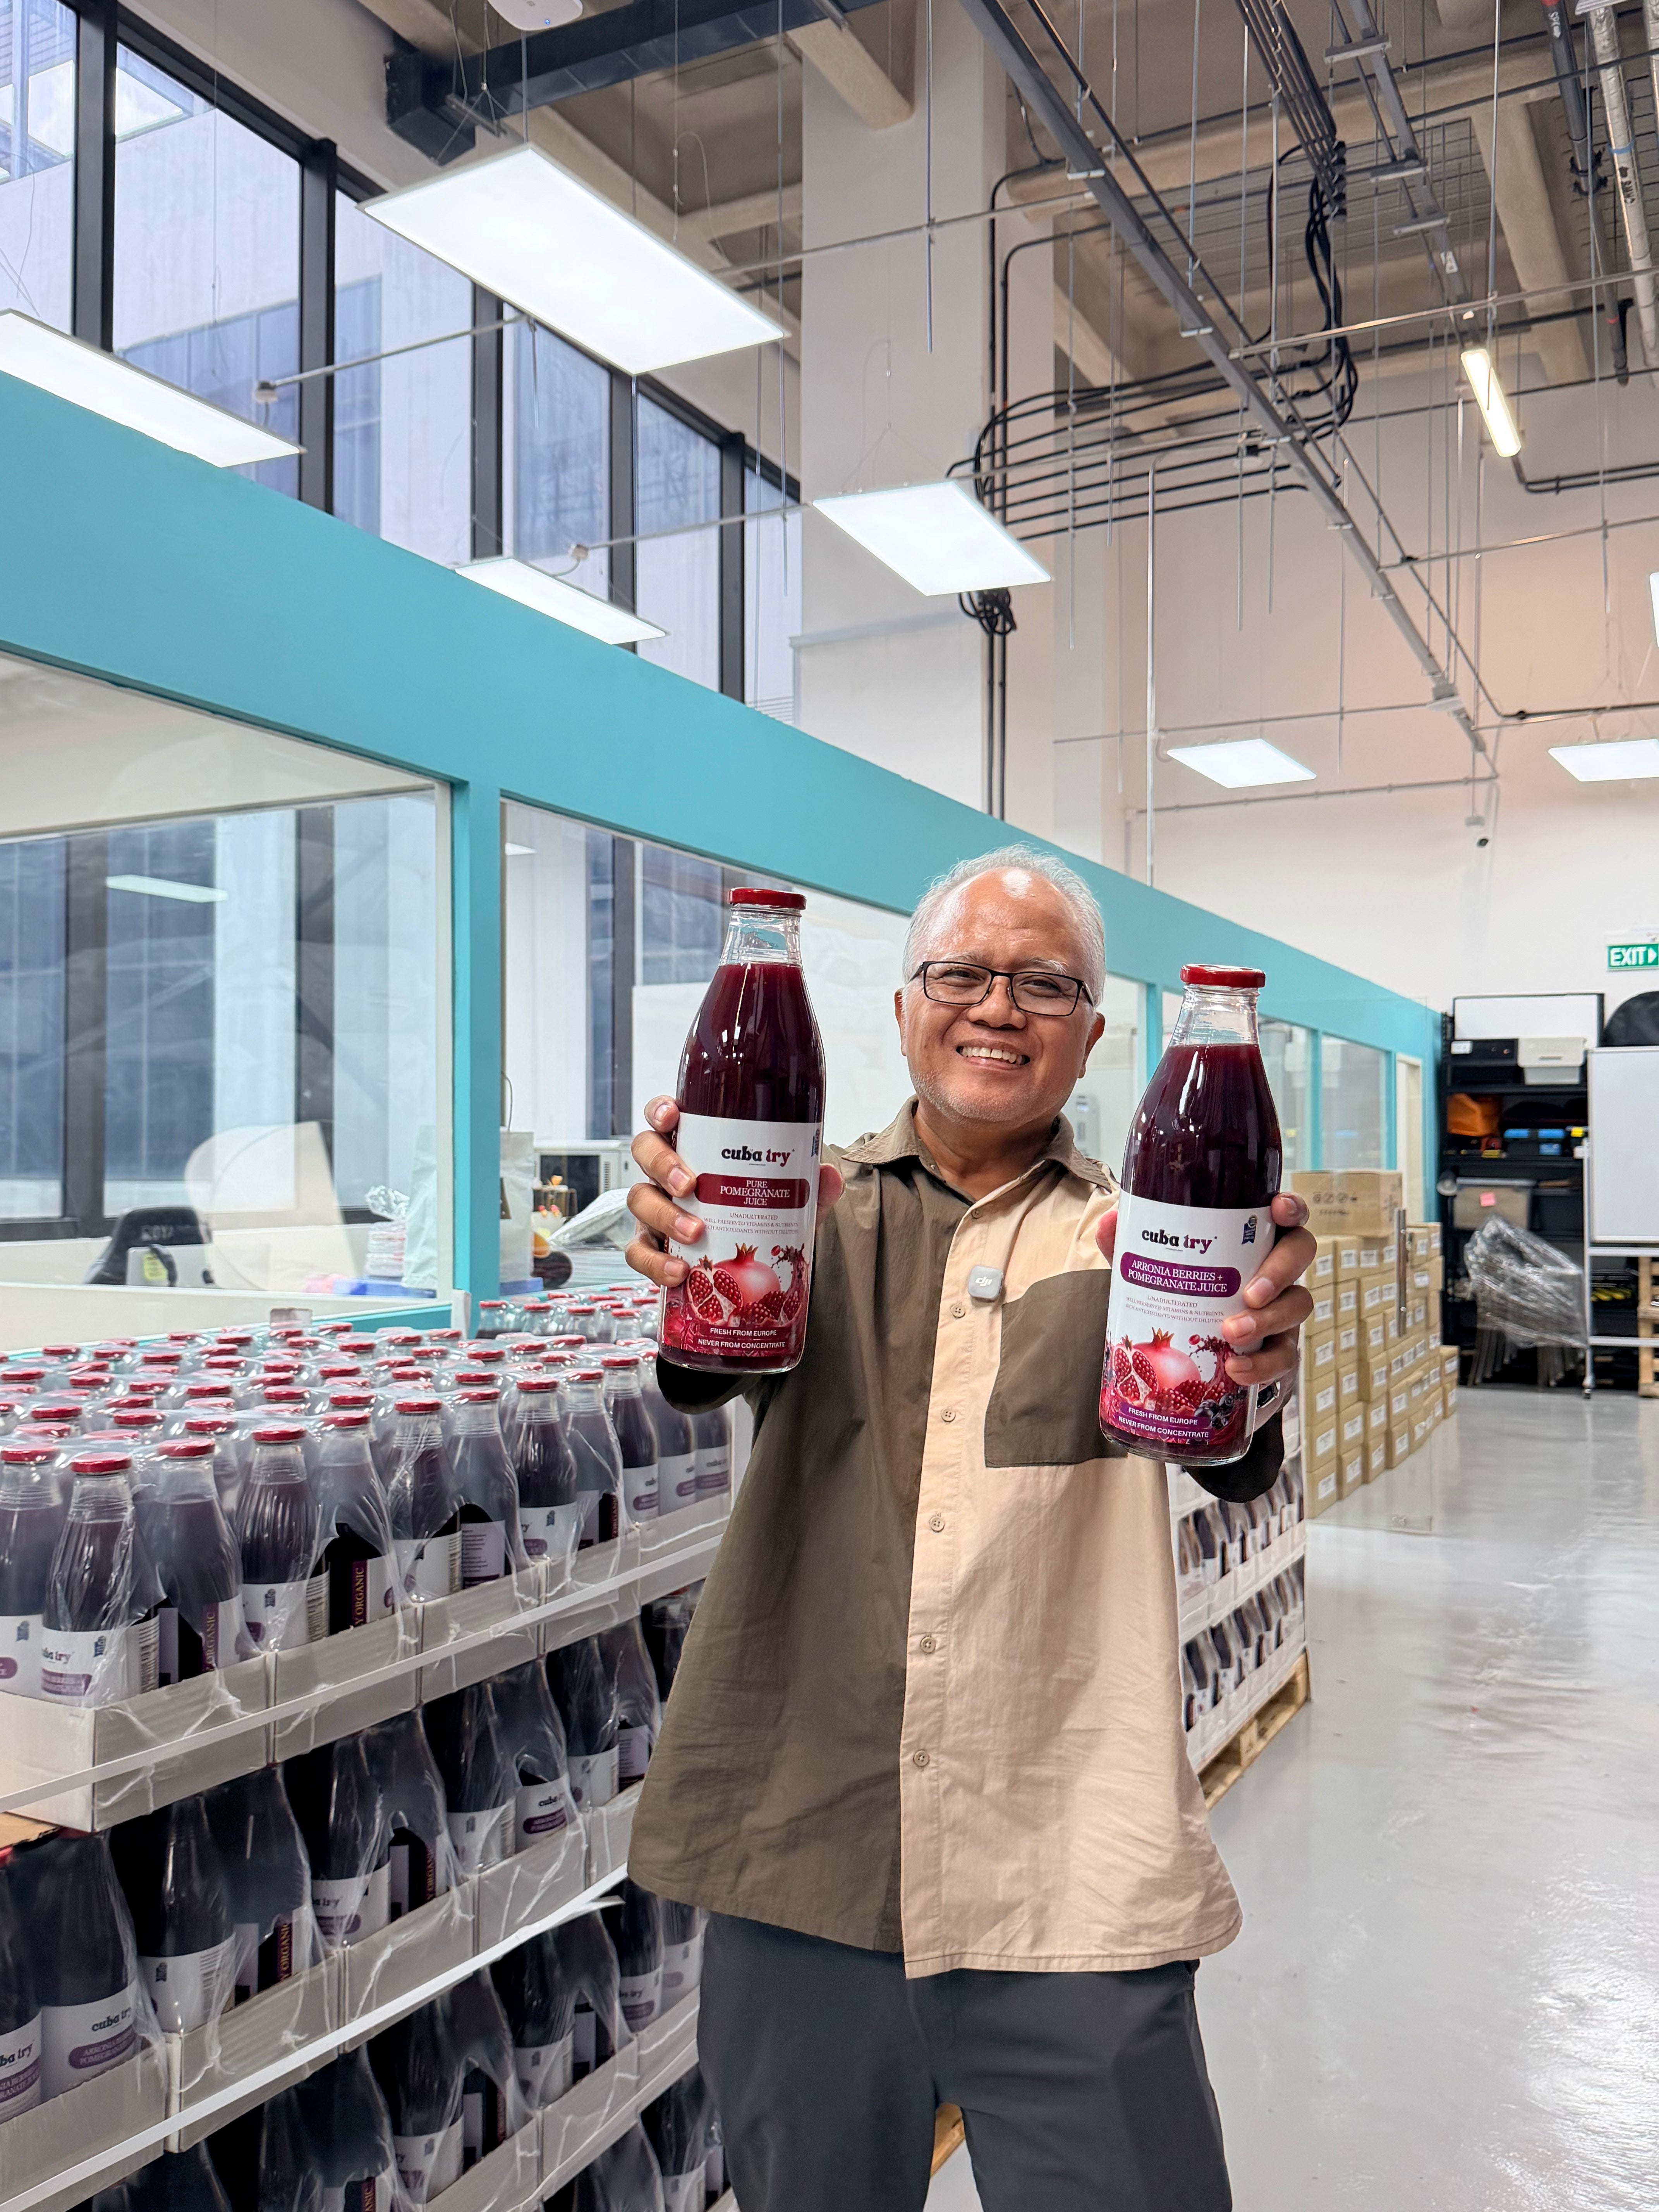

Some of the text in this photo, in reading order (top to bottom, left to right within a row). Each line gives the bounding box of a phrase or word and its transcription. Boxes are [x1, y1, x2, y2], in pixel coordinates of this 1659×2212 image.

[1610, 946, 1647, 966] EXIT
[721, 1146, 791, 1167] cuba try
[720, 1186, 790, 1198] POMEGRANATE
[746, 1180, 768, 1188] PURE
[744, 1197, 767, 1206] JUICE
[1142, 1229, 1212, 1254] cuba try
[1128, 1269, 1227, 1292] POMEGRANATE JUICE
[1132, 1260, 1170, 1276] ARRONIA
[1172, 1268, 1216, 1281] BERRIES
[1148, 1295, 1197, 1308] UNADULTERATED
[1163, 1307, 1188, 1315] VITAMINS
[1128, 1407, 1147, 1418] FRESH
[1149, 1413, 1168, 1422] FROM
[1119, 1416, 1209, 1437] NEVER FROM CONCENTRATE
[355, 1568, 364, 1615] ORGANIC
[206, 1612, 215, 1664] ORGANIC
